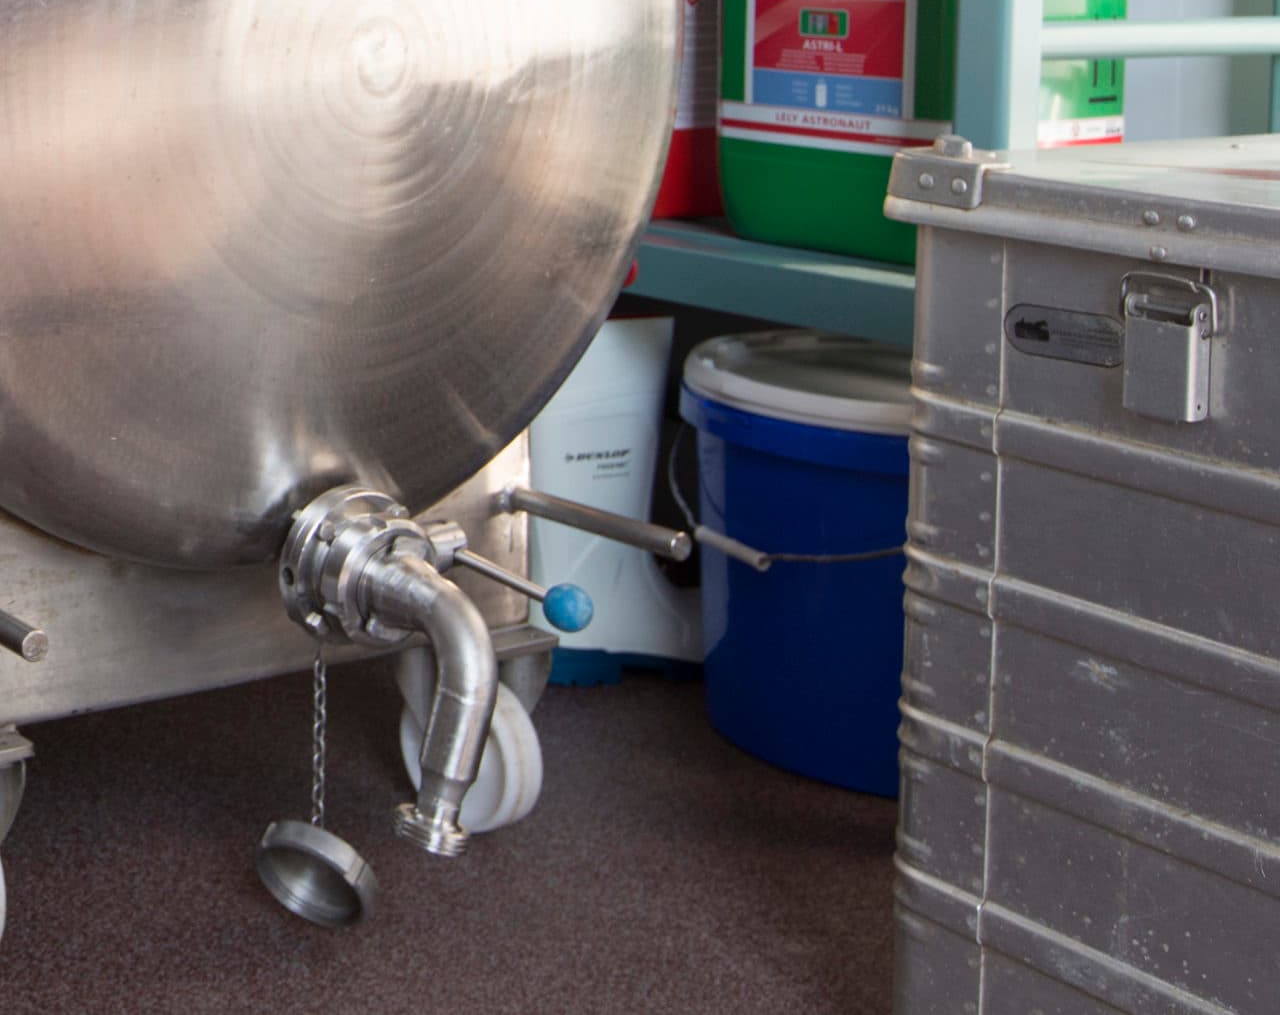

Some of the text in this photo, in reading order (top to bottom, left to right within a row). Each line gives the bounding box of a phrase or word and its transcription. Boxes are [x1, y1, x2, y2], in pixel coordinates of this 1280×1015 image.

[803, 40, 843, 52] ASTRI-L
[775, 112, 872, 130] LELY ASTRONAUT
